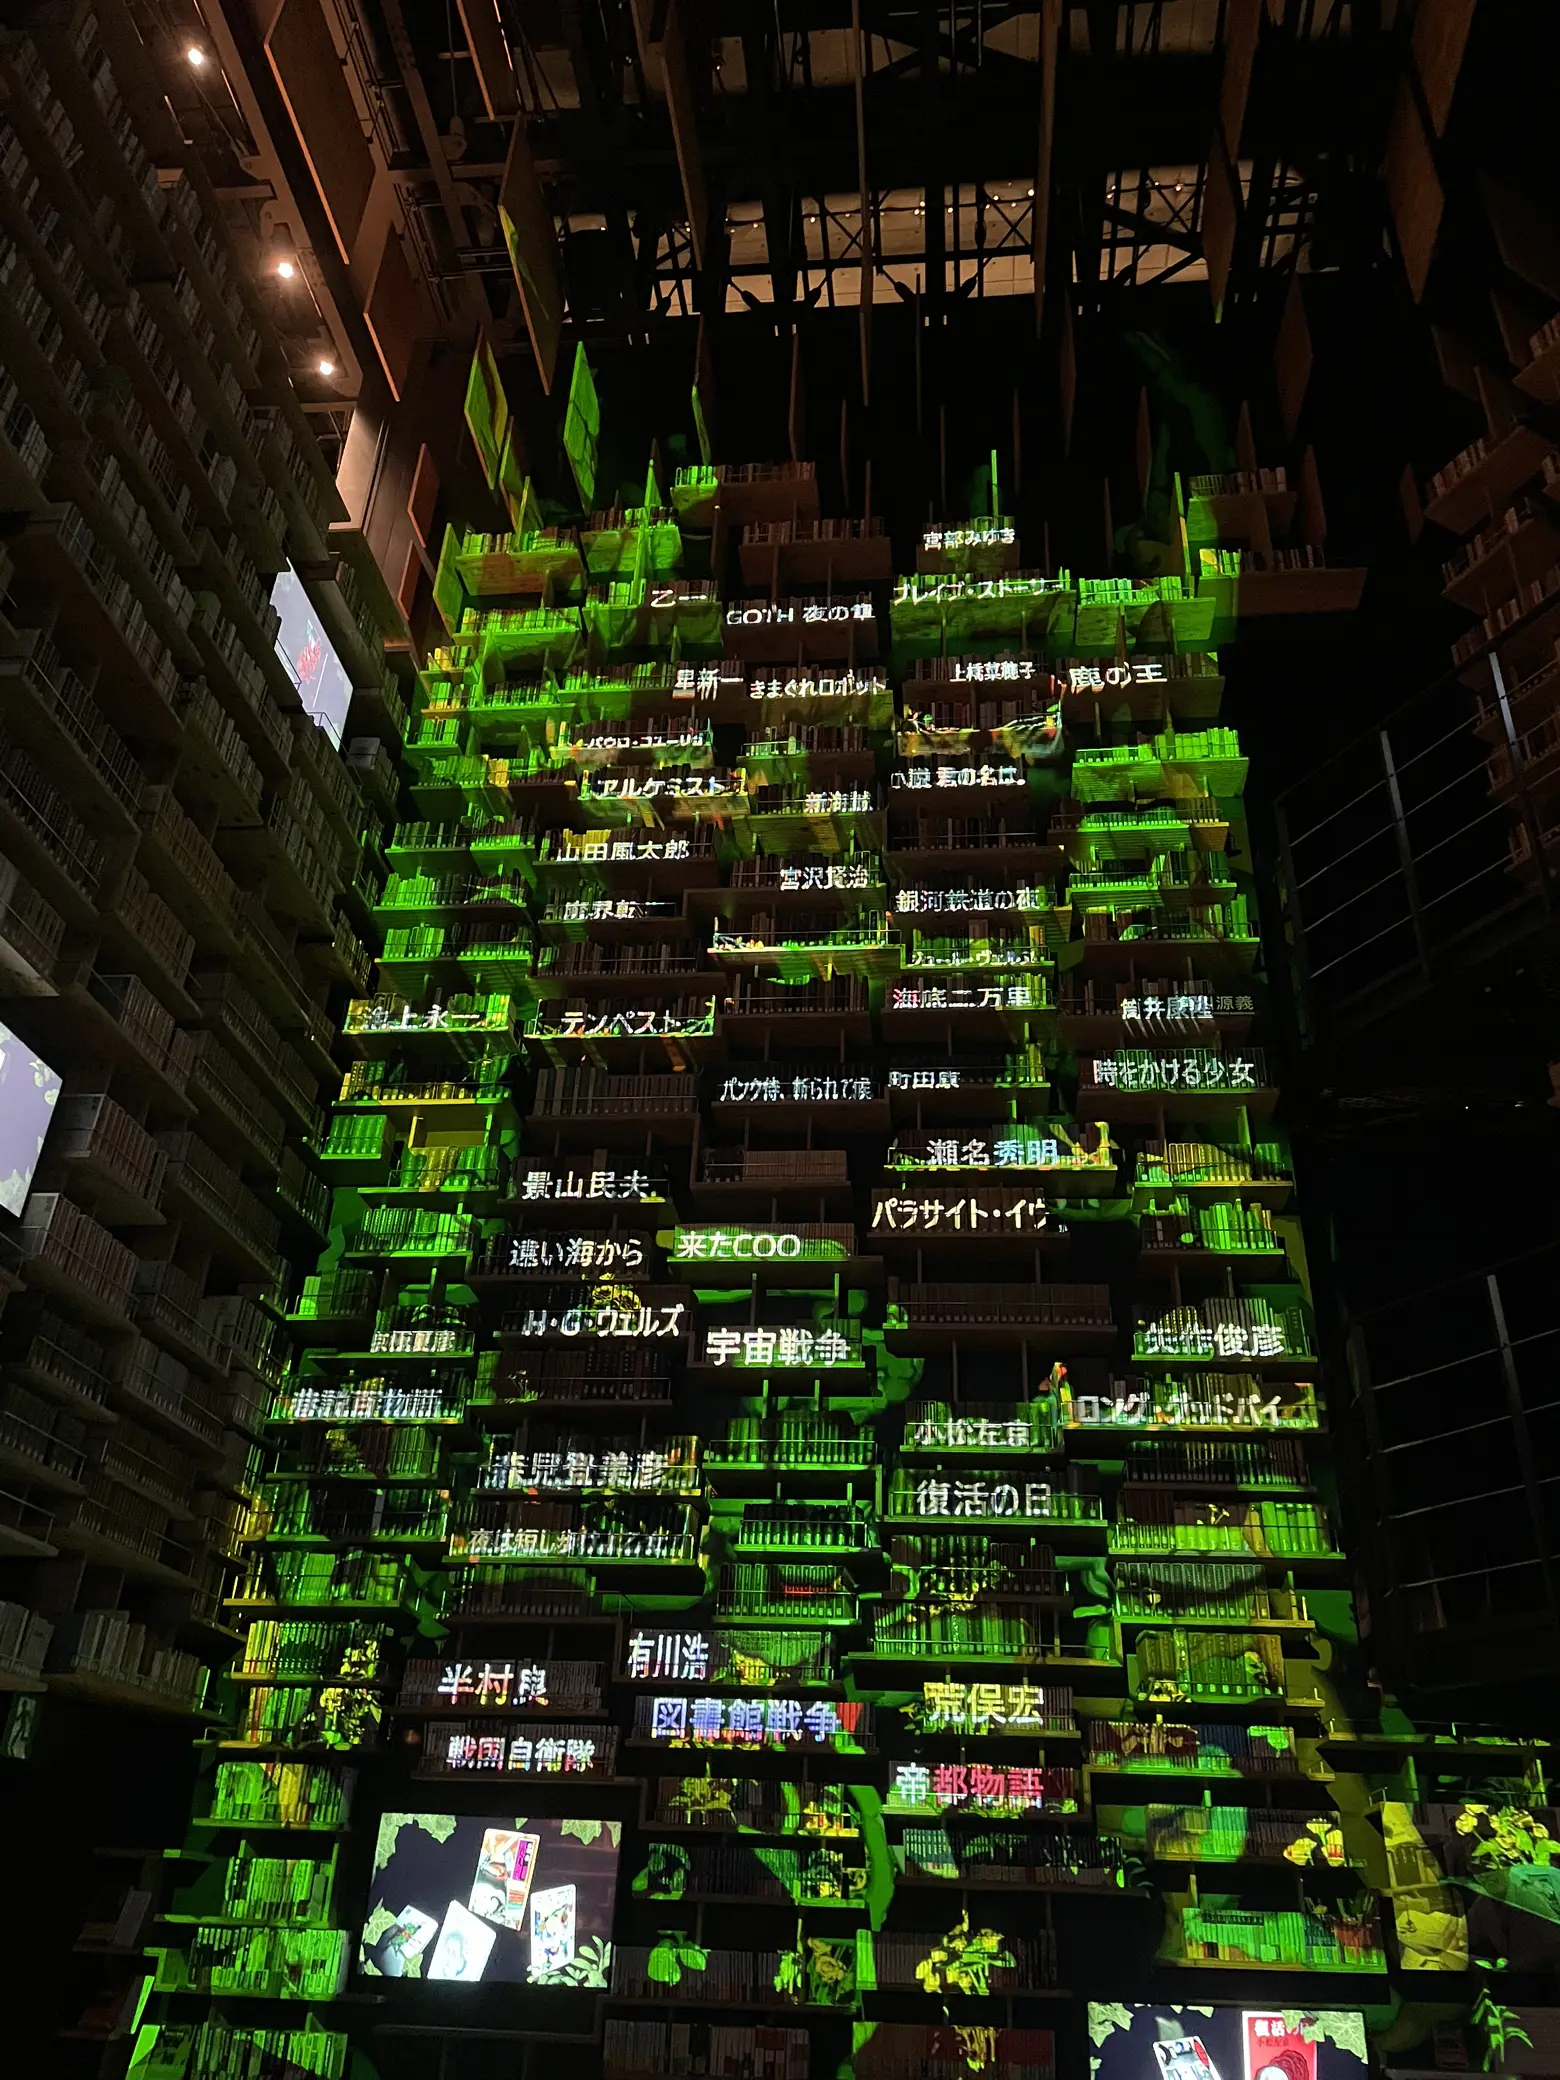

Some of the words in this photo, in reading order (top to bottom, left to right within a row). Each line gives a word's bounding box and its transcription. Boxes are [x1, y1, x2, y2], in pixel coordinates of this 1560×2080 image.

[650, 588, 708, 608] 乙一
[1067, 662, 1168, 693] 鹿の王
[1093, 1056, 1255, 1087] 時をかける少女
[521, 1169, 651, 1200] 景山民夫
[508, 1237, 644, 1268] 遠い海から
[706, 1328, 852, 1367] 宇宙戦争
[916, 1477, 1052, 1518] 復活の日
[627, 1631, 709, 1682] 有川浩
[651, 1696, 842, 1744] 図書館戦争
